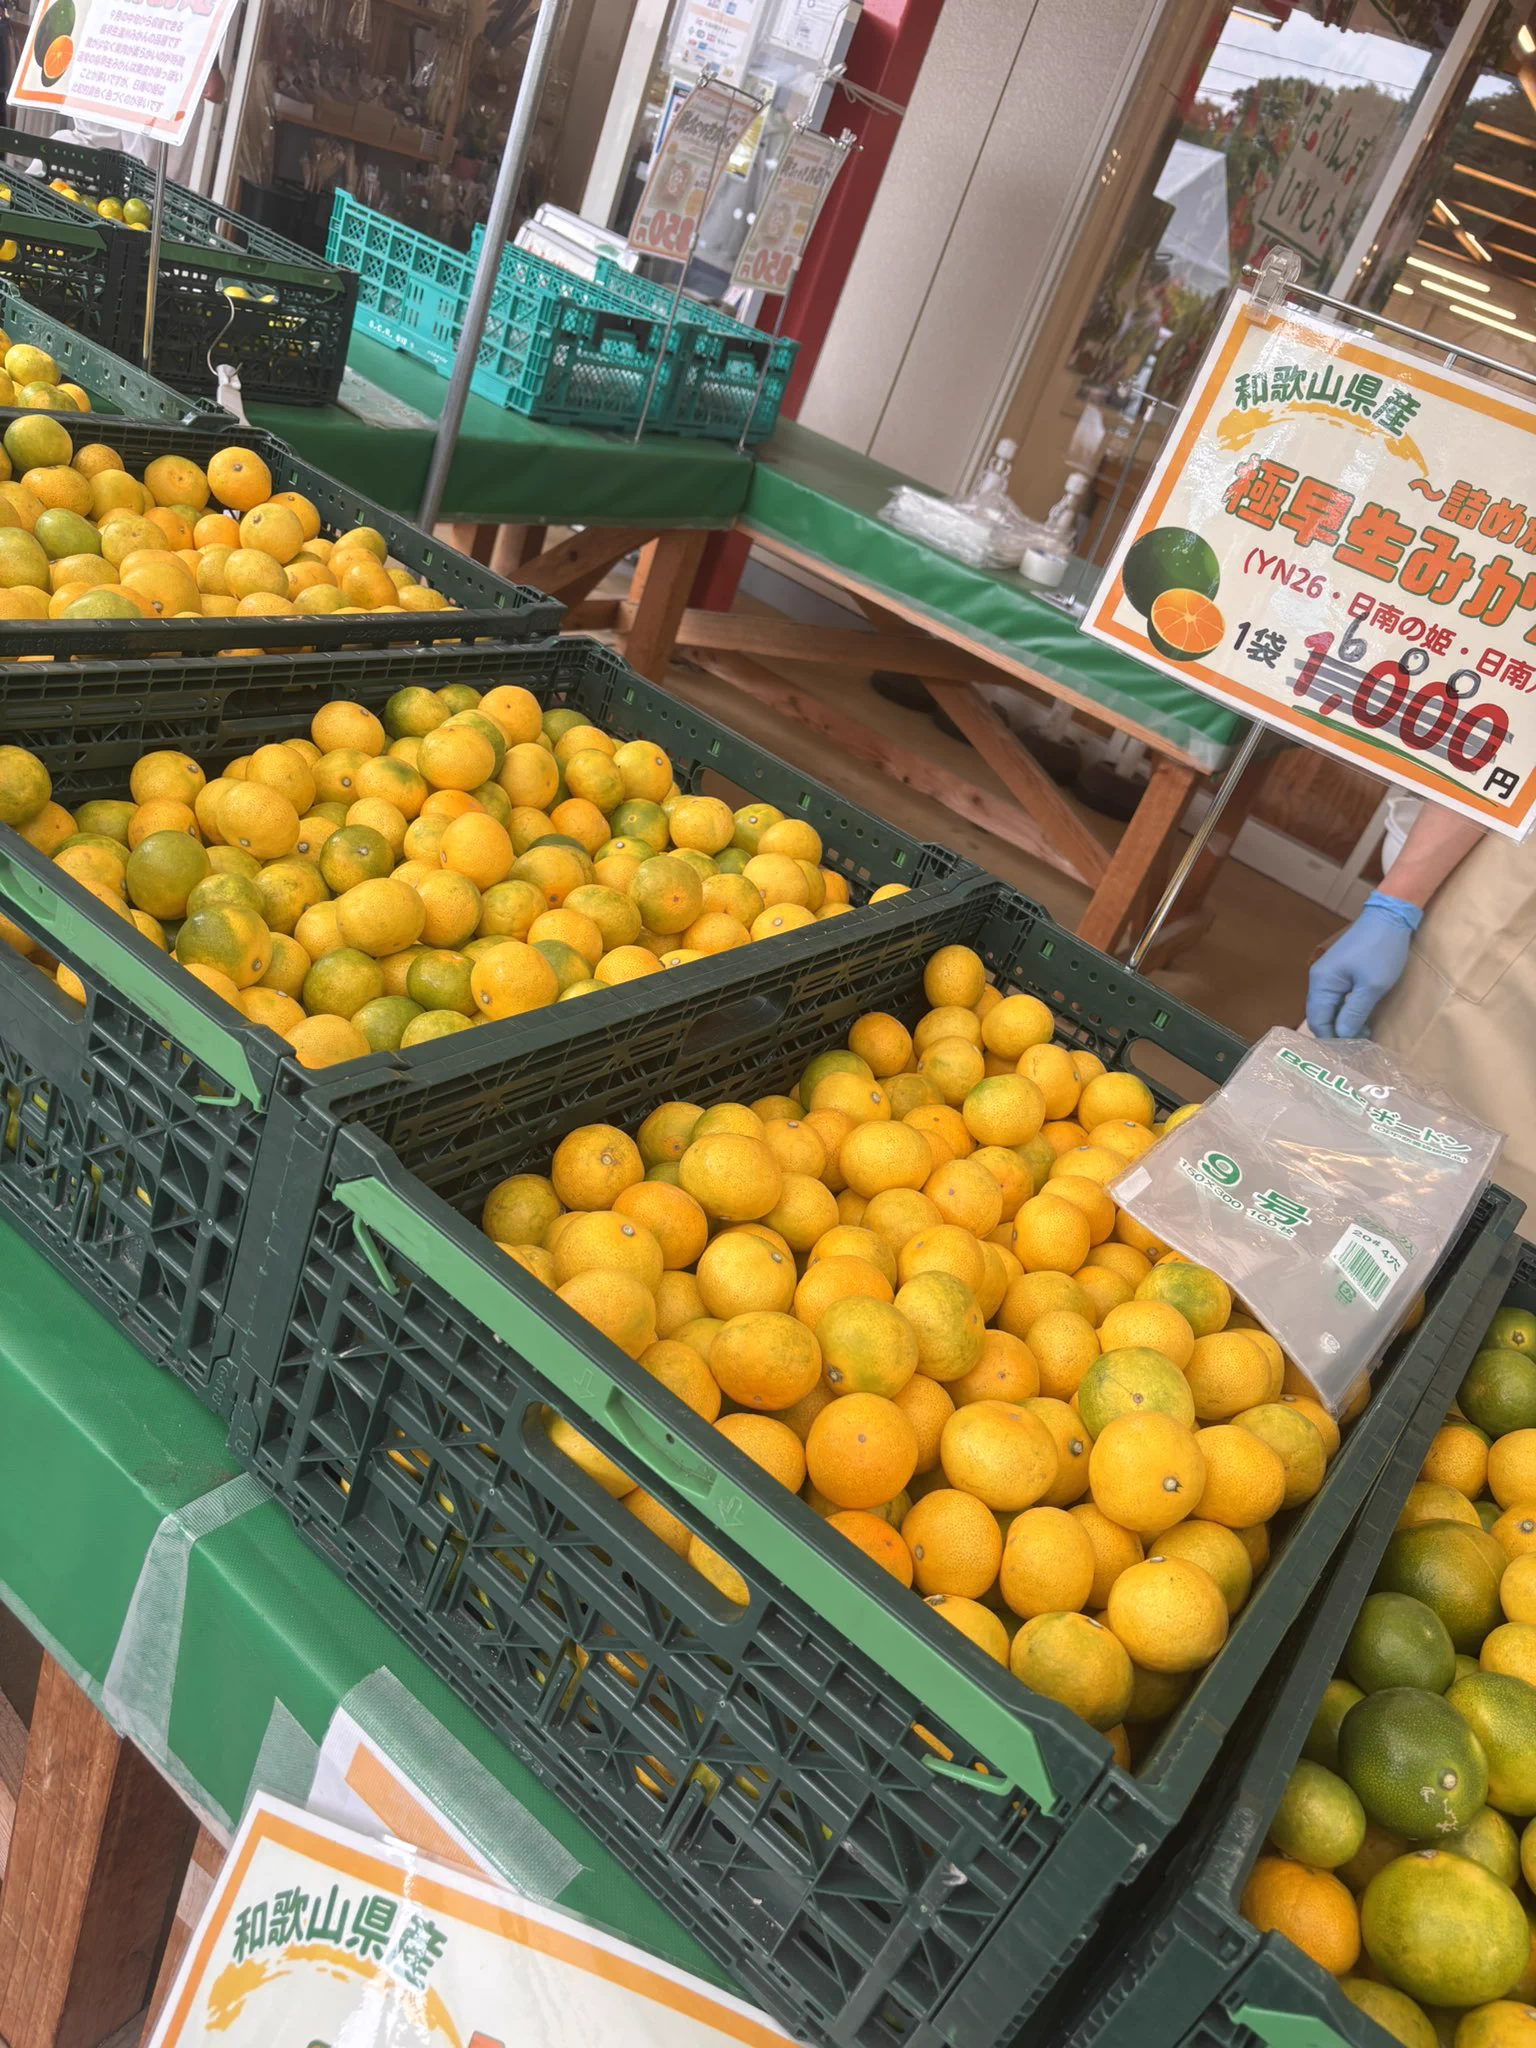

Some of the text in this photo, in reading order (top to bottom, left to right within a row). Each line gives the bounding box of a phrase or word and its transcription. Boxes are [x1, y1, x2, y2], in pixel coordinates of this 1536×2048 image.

[1234, 365, 1421, 437] 和歌山県産
[1243, 548, 1536, 694] (YN26・日南の姫・日南
[1371, 1109, 1472, 1152] ボードン
